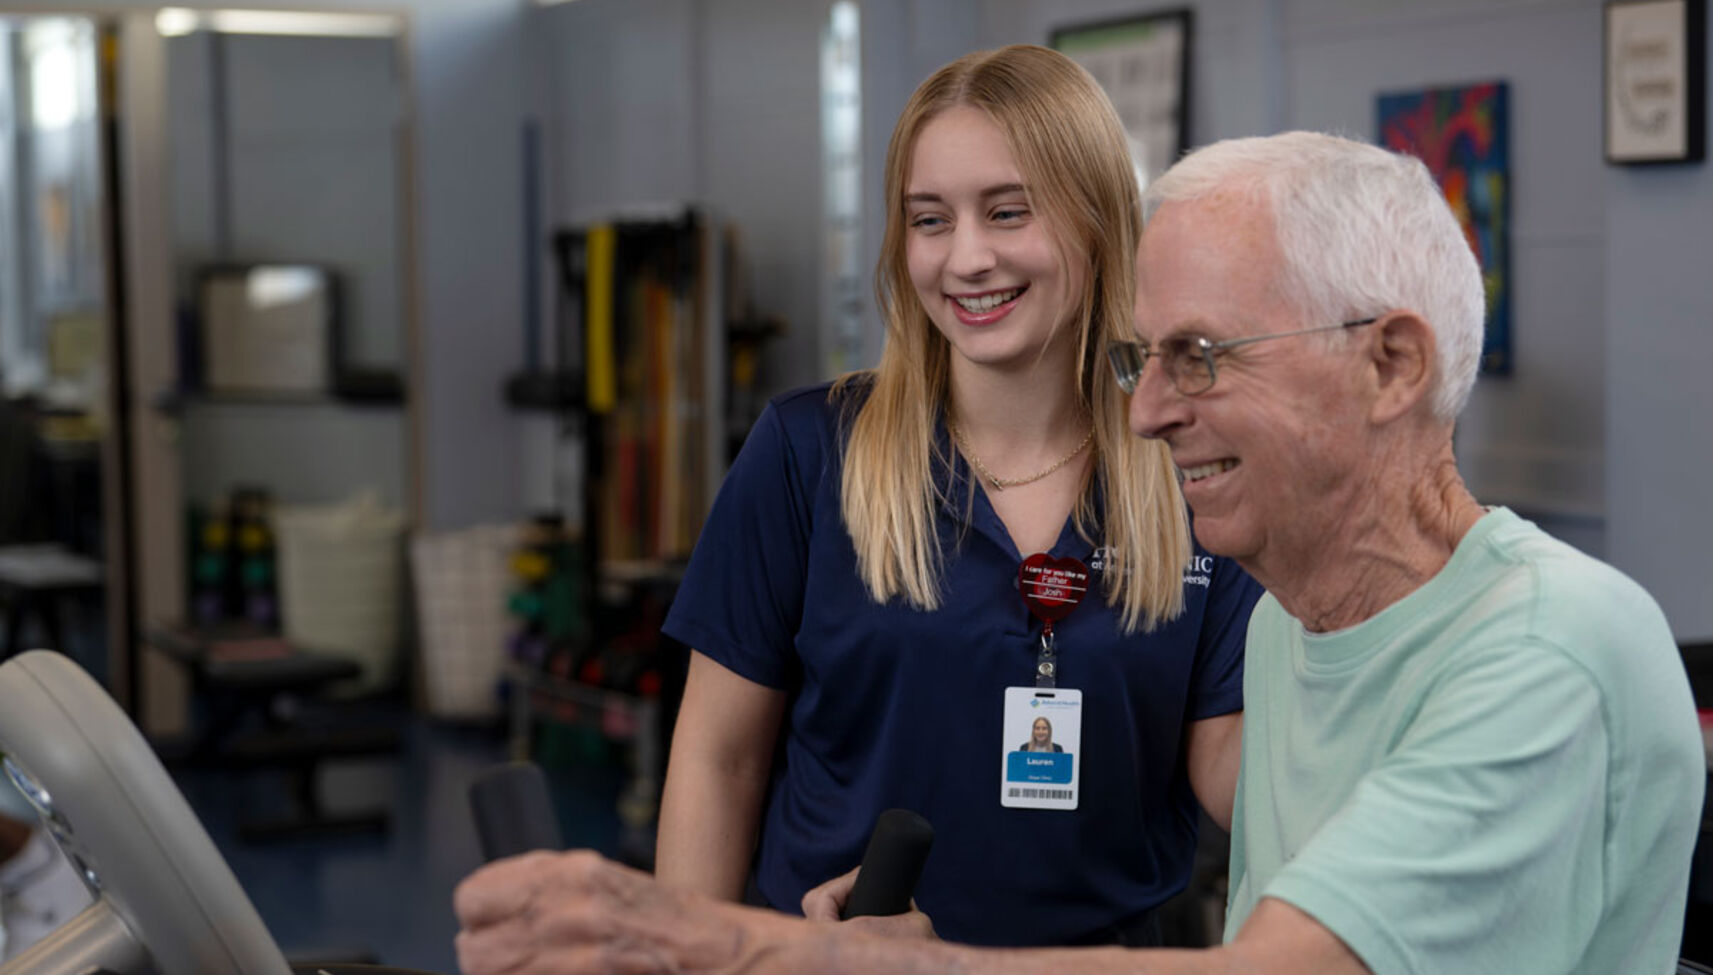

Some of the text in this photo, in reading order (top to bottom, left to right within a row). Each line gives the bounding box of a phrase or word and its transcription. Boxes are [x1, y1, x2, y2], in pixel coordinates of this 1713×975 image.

[1091, 560, 1103, 571] at
[1029, 566, 1042, 574] care
[1043, 567, 1052, 575] for
[1065, 570, 1077, 578] like
[1041, 575, 1069, 585] Father
[1183, 575, 1211, 589] versity
[1027, 757, 1055, 766] Lauren
